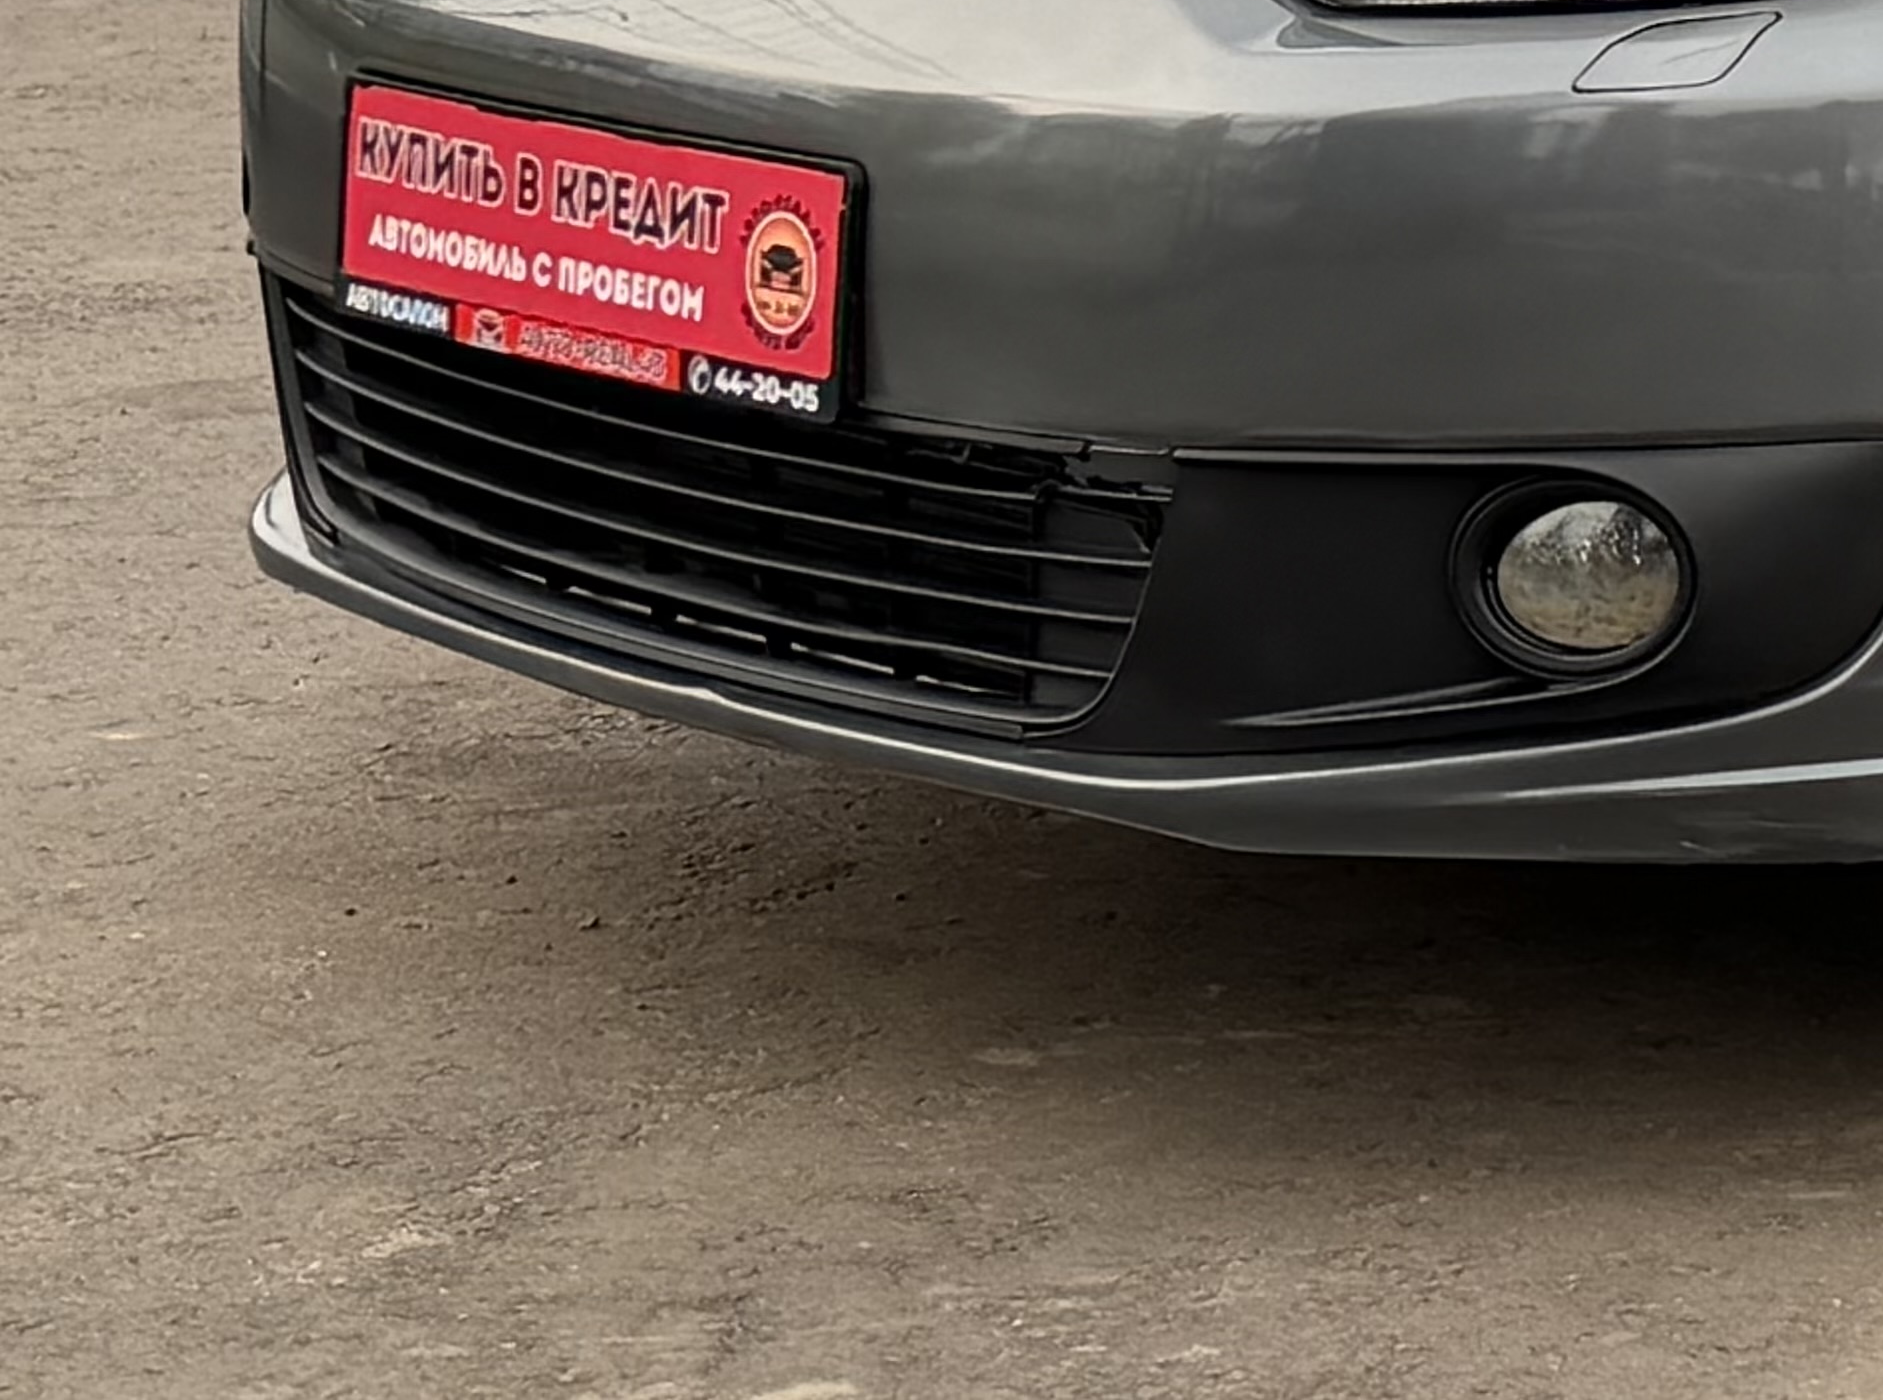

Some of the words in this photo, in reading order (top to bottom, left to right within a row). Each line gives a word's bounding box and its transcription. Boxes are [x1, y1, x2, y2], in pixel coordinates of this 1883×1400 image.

[356, 116, 506, 208] КУПИТЬ
[514, 152, 543, 216] В
[551, 159, 730, 255] КРЕДИТ
[368, 214, 527, 282] АВТОМОБИЛЬ
[532, 252, 553, 288] С
[558, 257, 705, 322] ПРОБЕГОМ
[714, 366, 820, 412] 44-20-05
